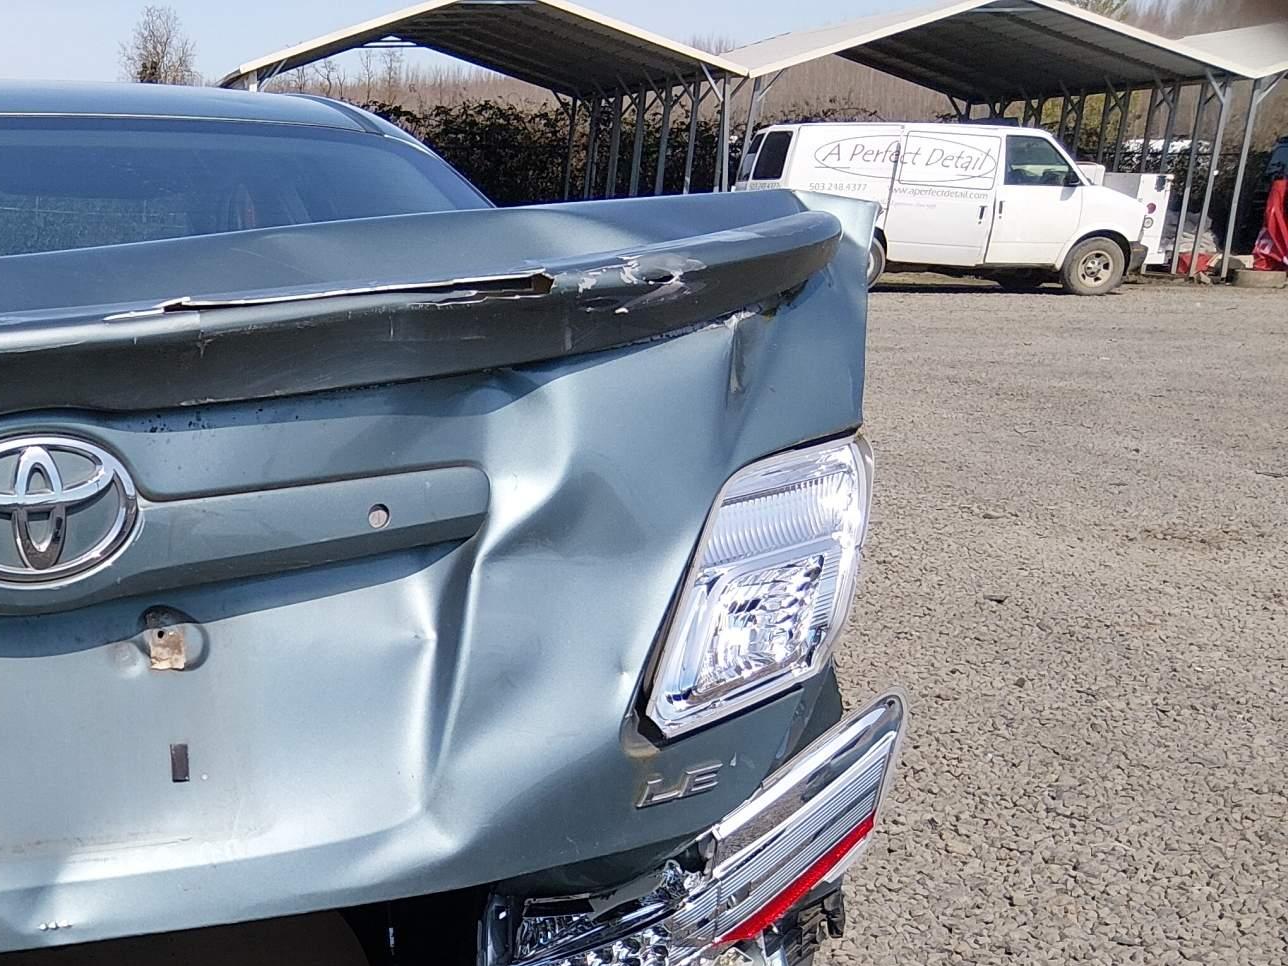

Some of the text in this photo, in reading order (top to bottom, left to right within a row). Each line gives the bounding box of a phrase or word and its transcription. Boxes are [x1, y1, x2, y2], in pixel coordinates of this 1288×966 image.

[821, 138, 992, 171] A Perfect Detail
[634, 759, 724, 810] LE
